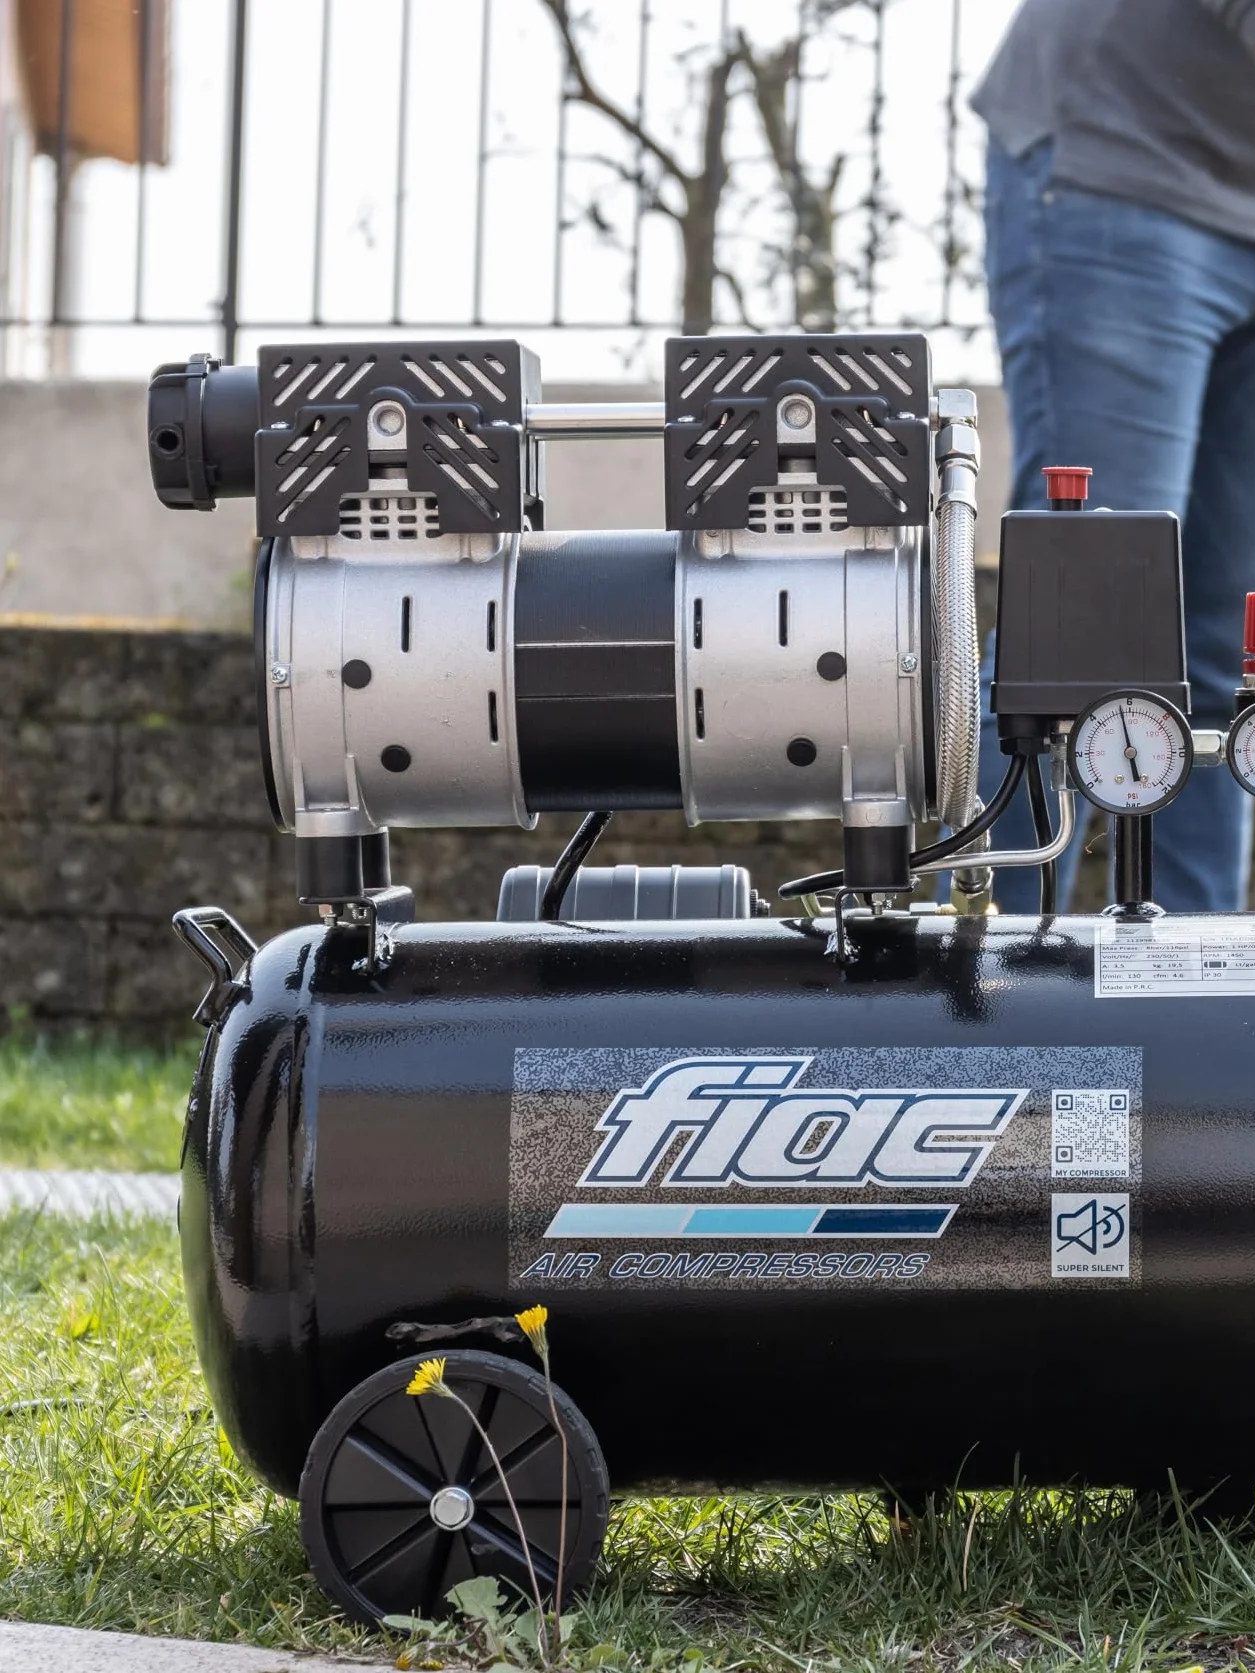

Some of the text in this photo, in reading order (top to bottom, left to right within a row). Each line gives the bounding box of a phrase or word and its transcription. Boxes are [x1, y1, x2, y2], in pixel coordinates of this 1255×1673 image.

[1126, 697, 1133, 706] 6
[1162, 711, 1171, 721] 8
[576, 1056, 1031, 1188] fiac
[1055, 1169, 1127, 1177] MY COMPRESSOR
[519, 1251, 934, 1279] AIR COMPRESSORS
[1057, 1264, 1125, 1272] SUPER SILENT
